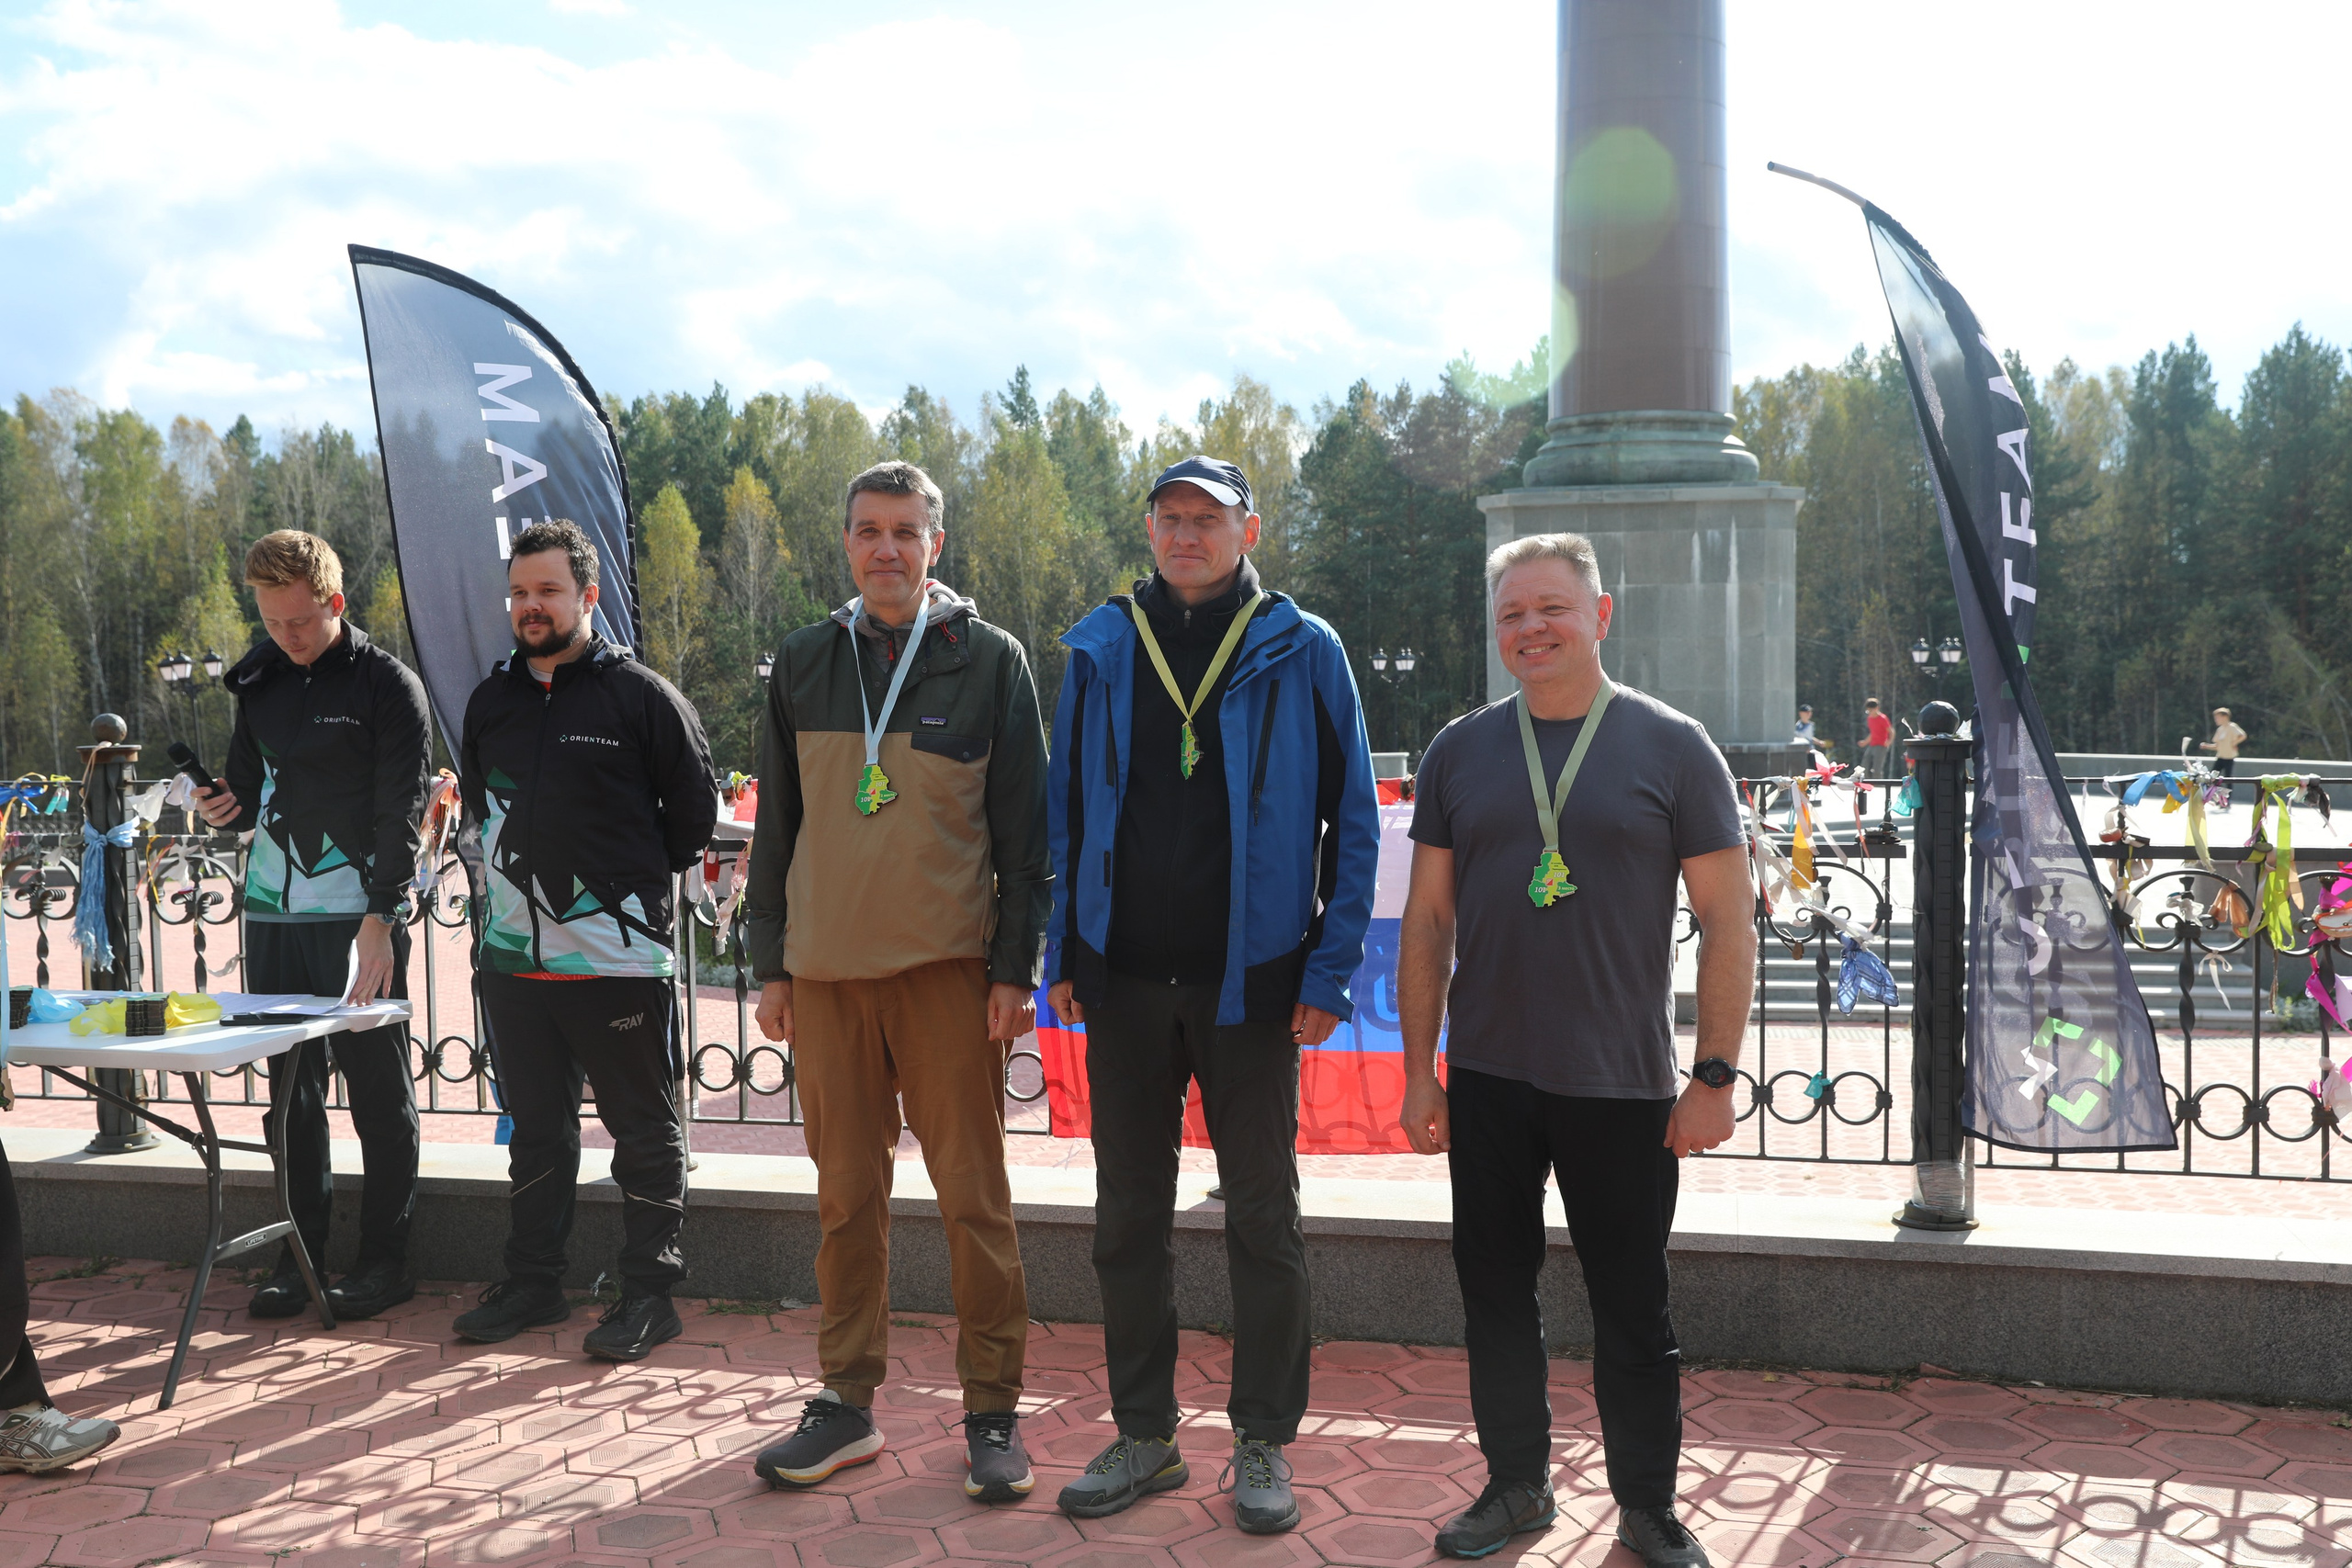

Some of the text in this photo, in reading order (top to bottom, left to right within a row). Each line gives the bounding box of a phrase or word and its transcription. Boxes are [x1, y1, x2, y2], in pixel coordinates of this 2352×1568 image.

[323, 716, 361, 725] ORIENTEAM
[570, 735, 619, 746] ORIENTEAM
[609, 1012, 644, 1032] RAY
